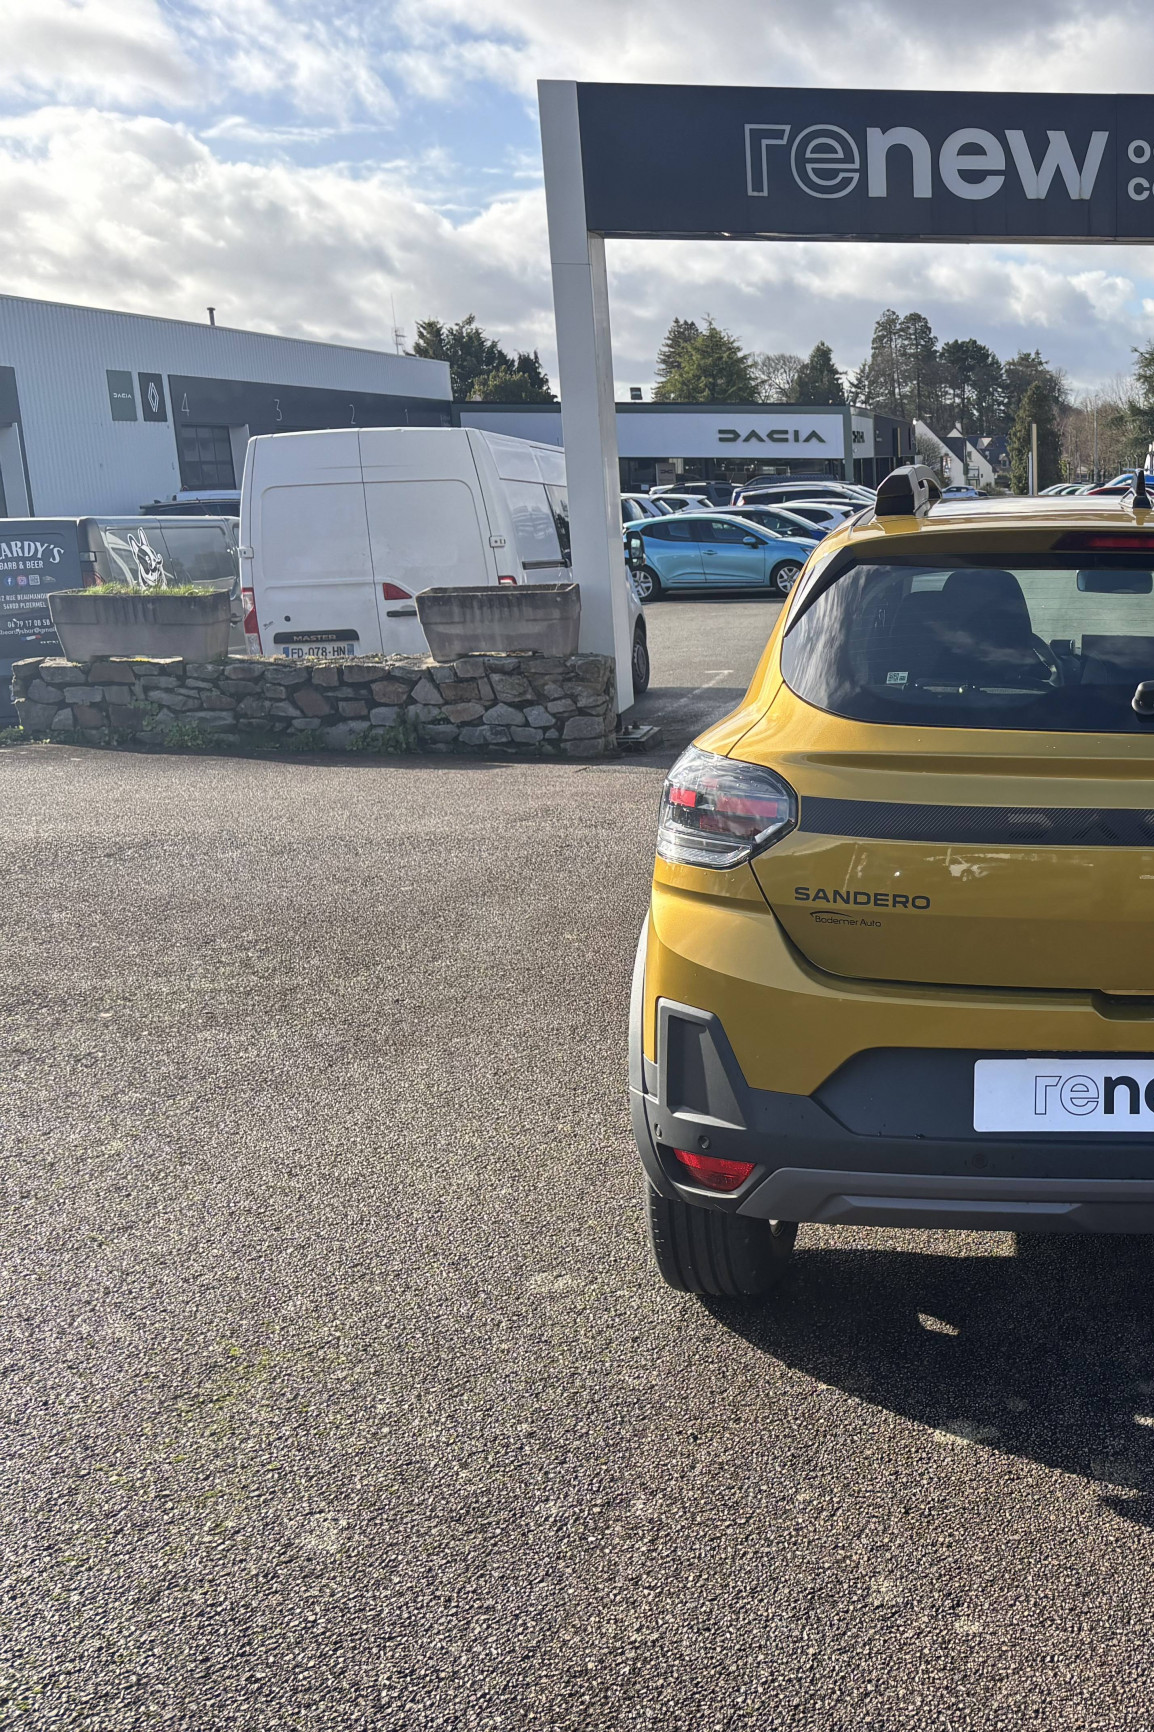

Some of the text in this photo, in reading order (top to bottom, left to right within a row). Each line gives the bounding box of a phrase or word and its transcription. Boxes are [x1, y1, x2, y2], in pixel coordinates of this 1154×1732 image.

[743, 123, 1109, 200] renew
[181, 392, 190, 416] 4
[274, 399, 283, 421] 3
[349, 404, 356, 424] 2
[718, 428, 826, 443] DACIA
[0, 540, 65, 563] ARDY'S
[26, 560, 44, 569] BEER
[293, 634, 337, 642] MASTER
[794, 886, 931, 910] SANDERO
[859, 918, 882, 928] Auto
